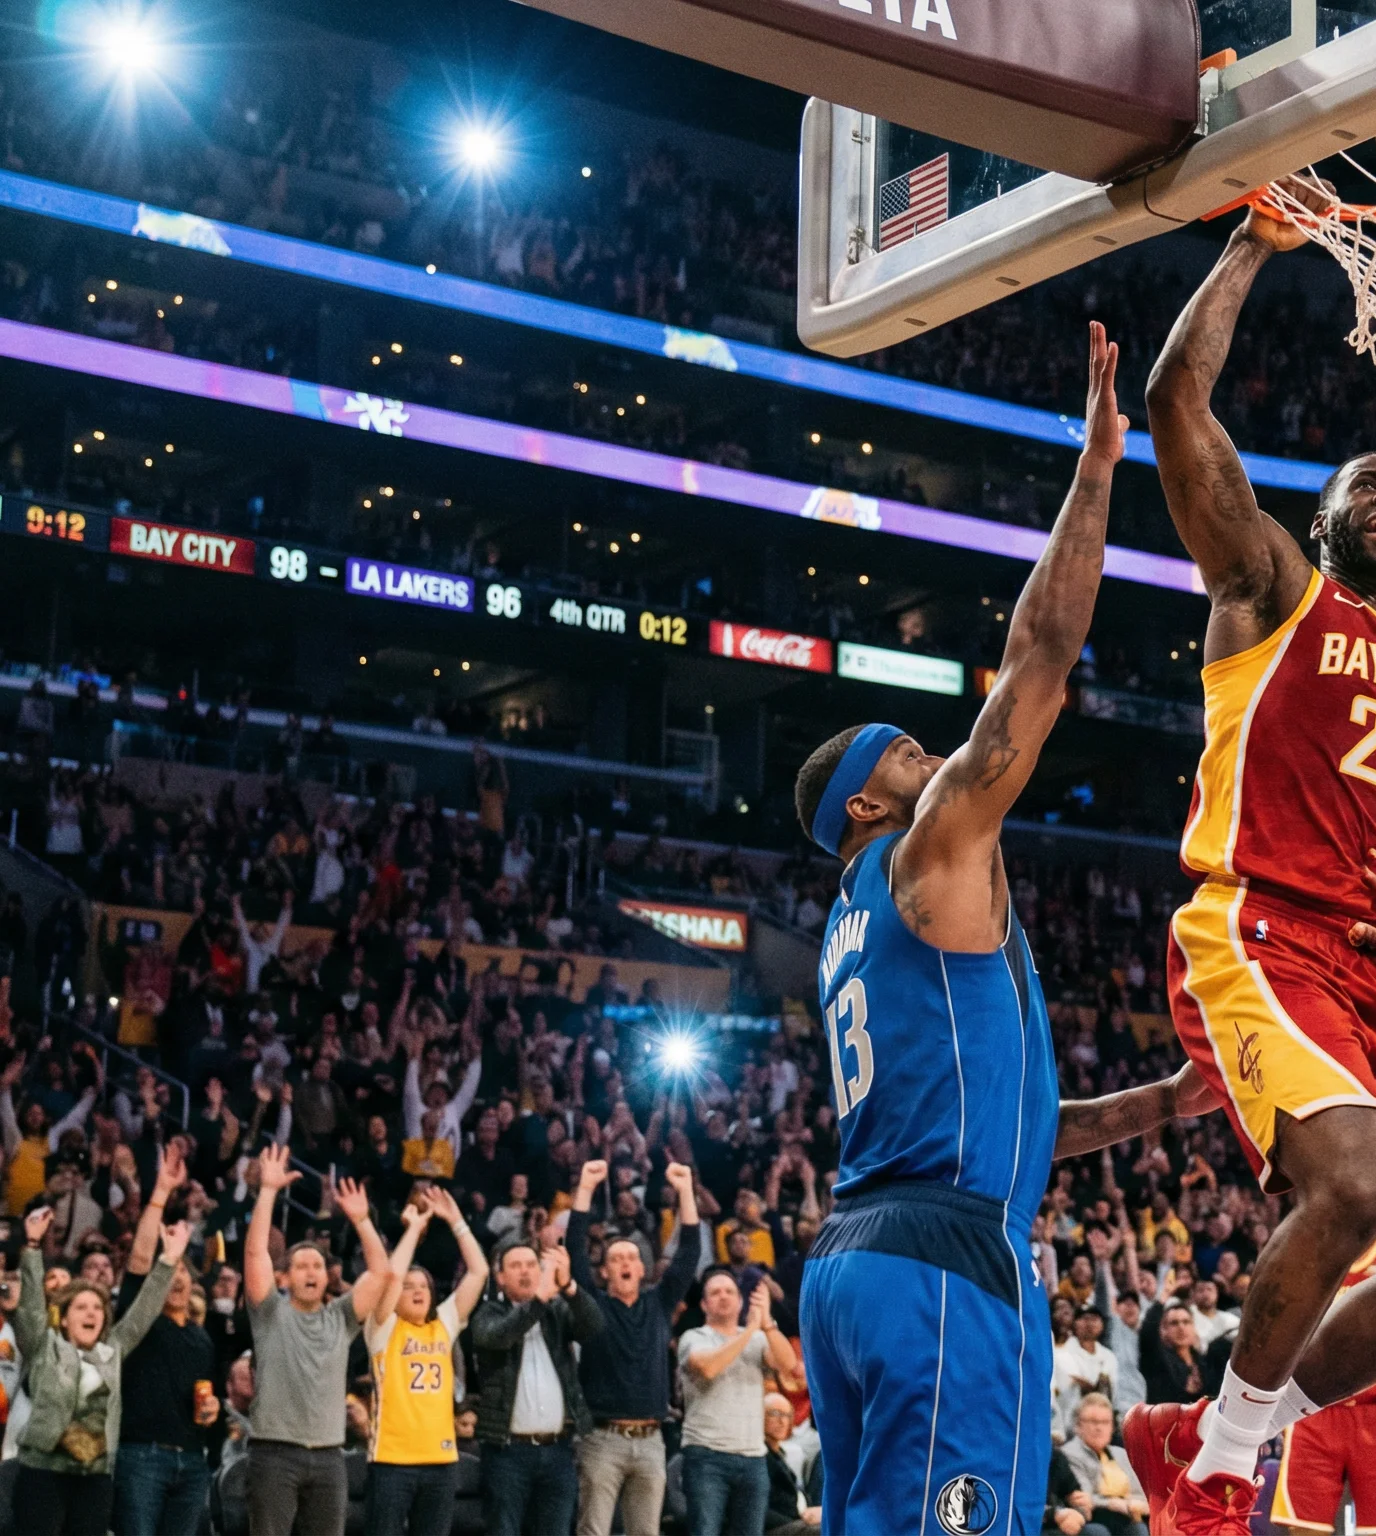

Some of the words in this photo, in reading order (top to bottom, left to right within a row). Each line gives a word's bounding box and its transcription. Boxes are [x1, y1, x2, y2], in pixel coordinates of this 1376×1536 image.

[26, 505, 86, 542] 9:12
[129, 523, 180, 557] BAY
[181, 533, 237, 567] CITY
[270, 546, 308, 582] 98
[351, 562, 381, 593] LA
[385, 568, 470, 608] LAKERS
[486, 583, 522, 619] 96
[549, 598, 583, 626] 4th
[586, 603, 626, 634] QTR
[639, 611, 688, 645] 0:12
[825, 977, 874, 1120] 13
[410, 1362, 442, 1391] 23
